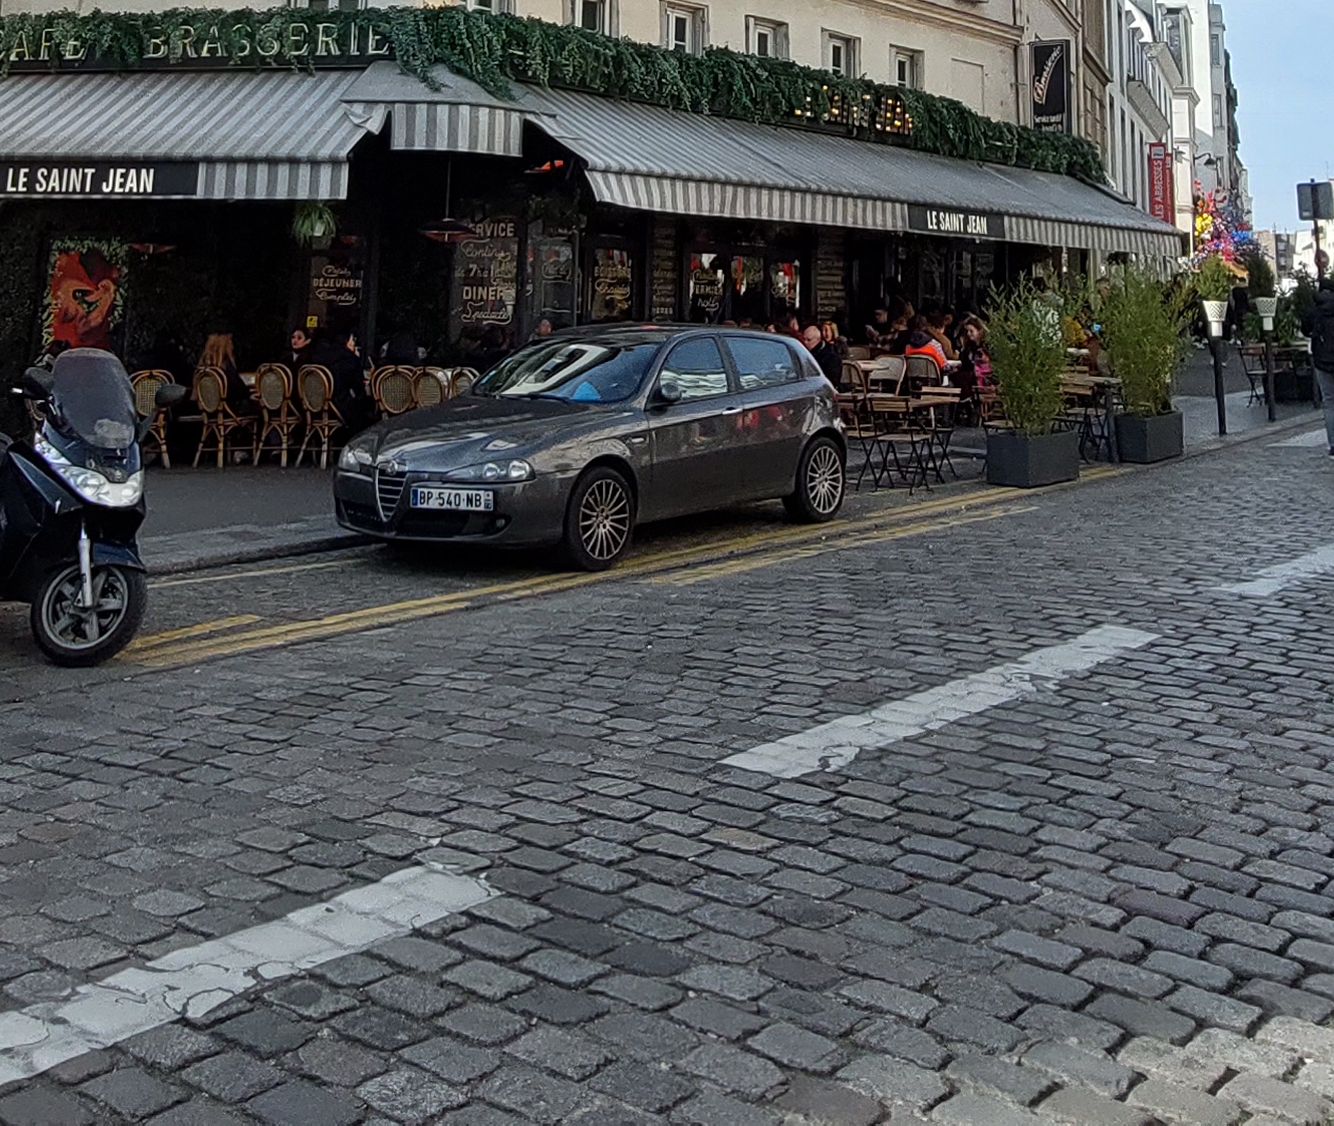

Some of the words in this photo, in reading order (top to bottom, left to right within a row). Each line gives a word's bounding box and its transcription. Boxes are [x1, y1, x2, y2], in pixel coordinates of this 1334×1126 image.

[142, 21, 391, 60] BRASSERIE
[6, 167, 30, 192] LE
[35, 167, 96, 192] SAINT
[102, 168, 155, 193] JEAN
[927, 210, 938, 230] LE
[939, 211, 965, 232] SAINT
[967, 215, 987, 234] JEAN
